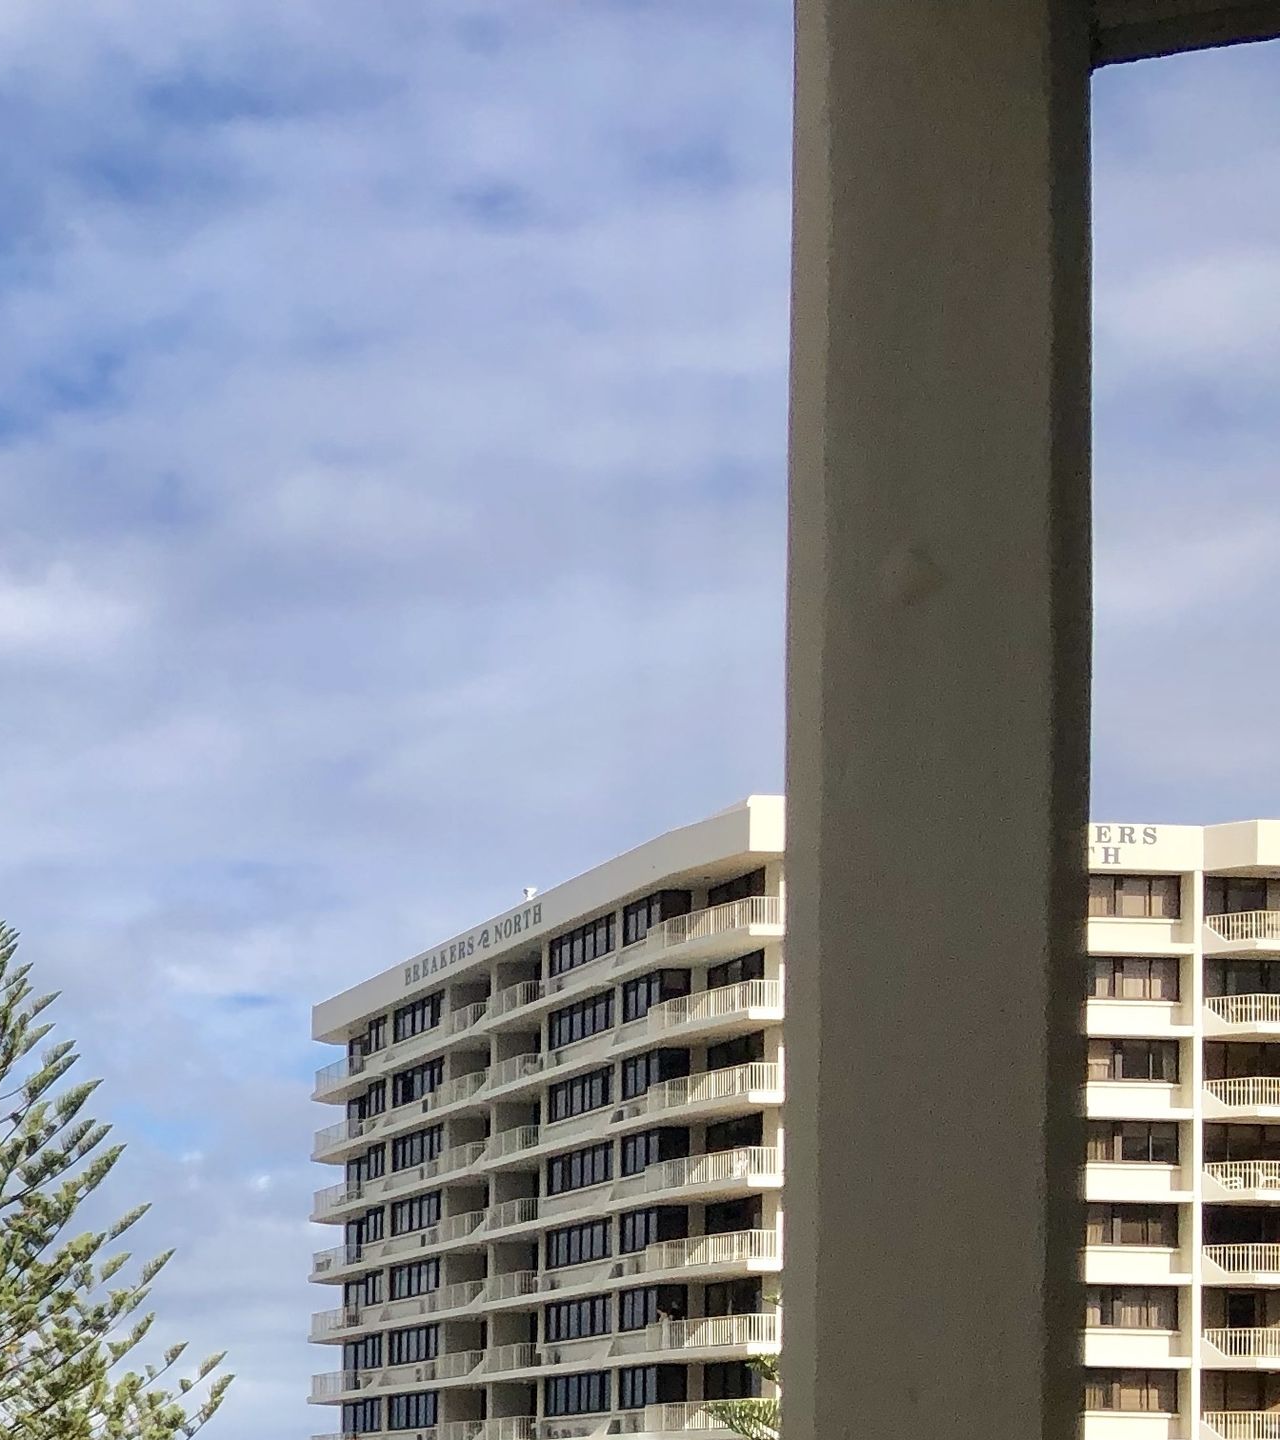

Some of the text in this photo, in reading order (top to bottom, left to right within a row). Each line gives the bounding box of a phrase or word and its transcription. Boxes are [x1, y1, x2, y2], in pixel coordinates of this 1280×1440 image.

[1095, 825, 1157, 845] ERS
[404, 902, 542, 986] BREAKERS NORTH
